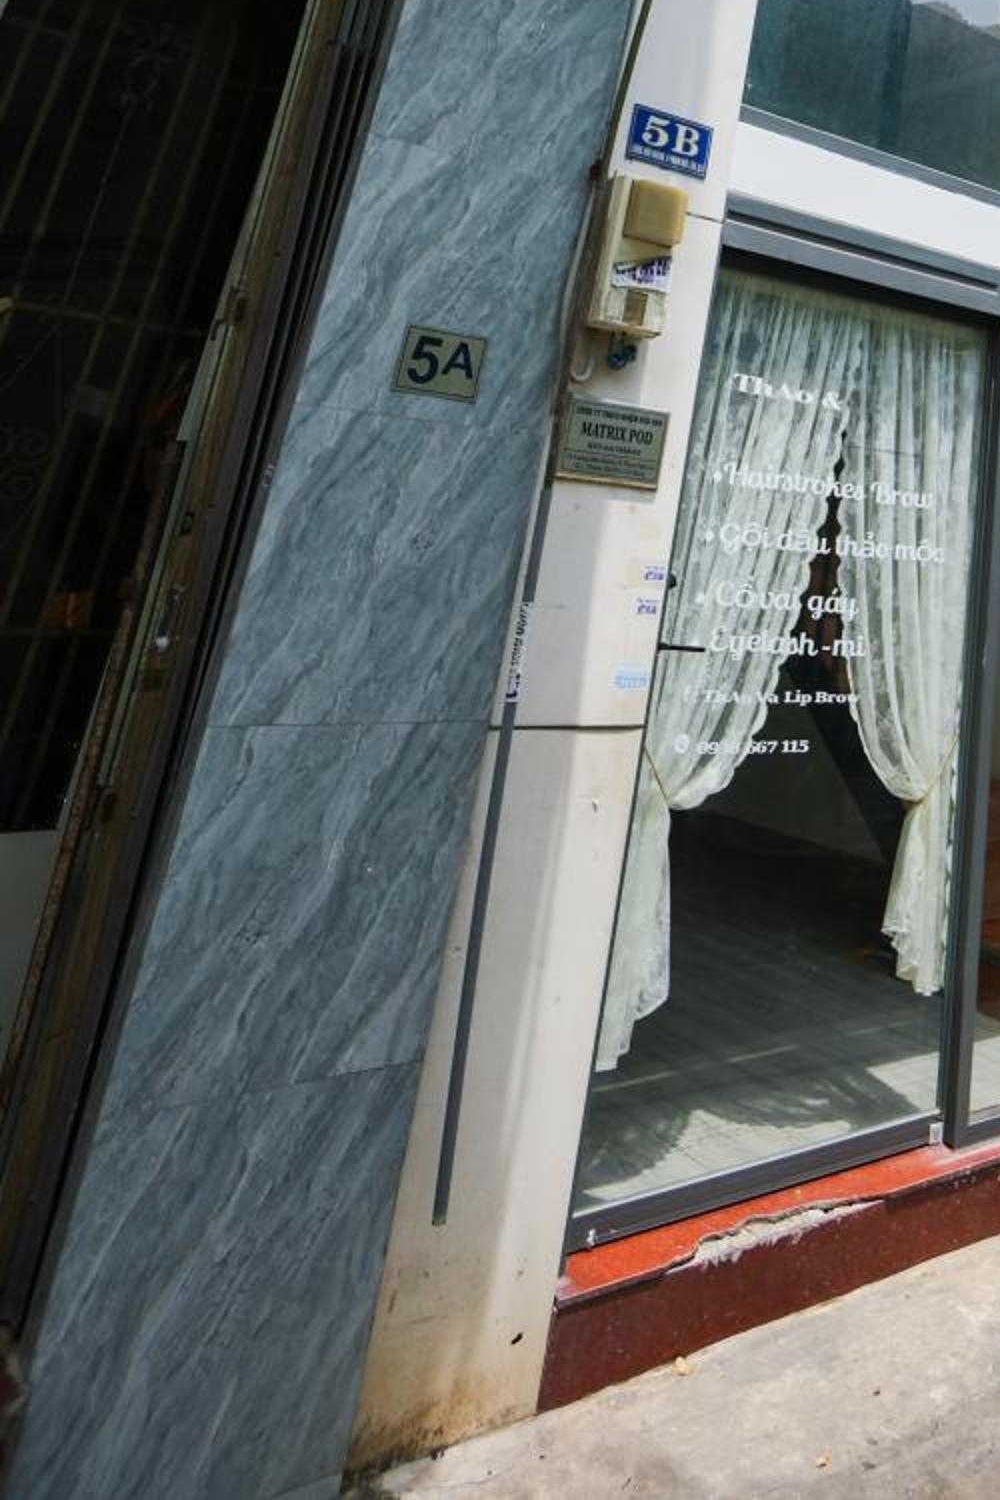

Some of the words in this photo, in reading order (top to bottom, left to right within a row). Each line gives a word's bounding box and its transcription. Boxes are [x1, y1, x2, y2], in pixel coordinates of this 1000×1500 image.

[642, 115, 700, 157] 5B
[407, 335, 474, 385] 5A
[582, 421, 627, 441] MATRIX
[870, 481, 933, 508] Brow
[807, 587, 860, 621] gáy
[711, 626, 818, 660] Eyelash
[783, 689, 812, 707] Lip
[815, 690, 860, 704] Brow
[782, 739, 810, 754] 115
